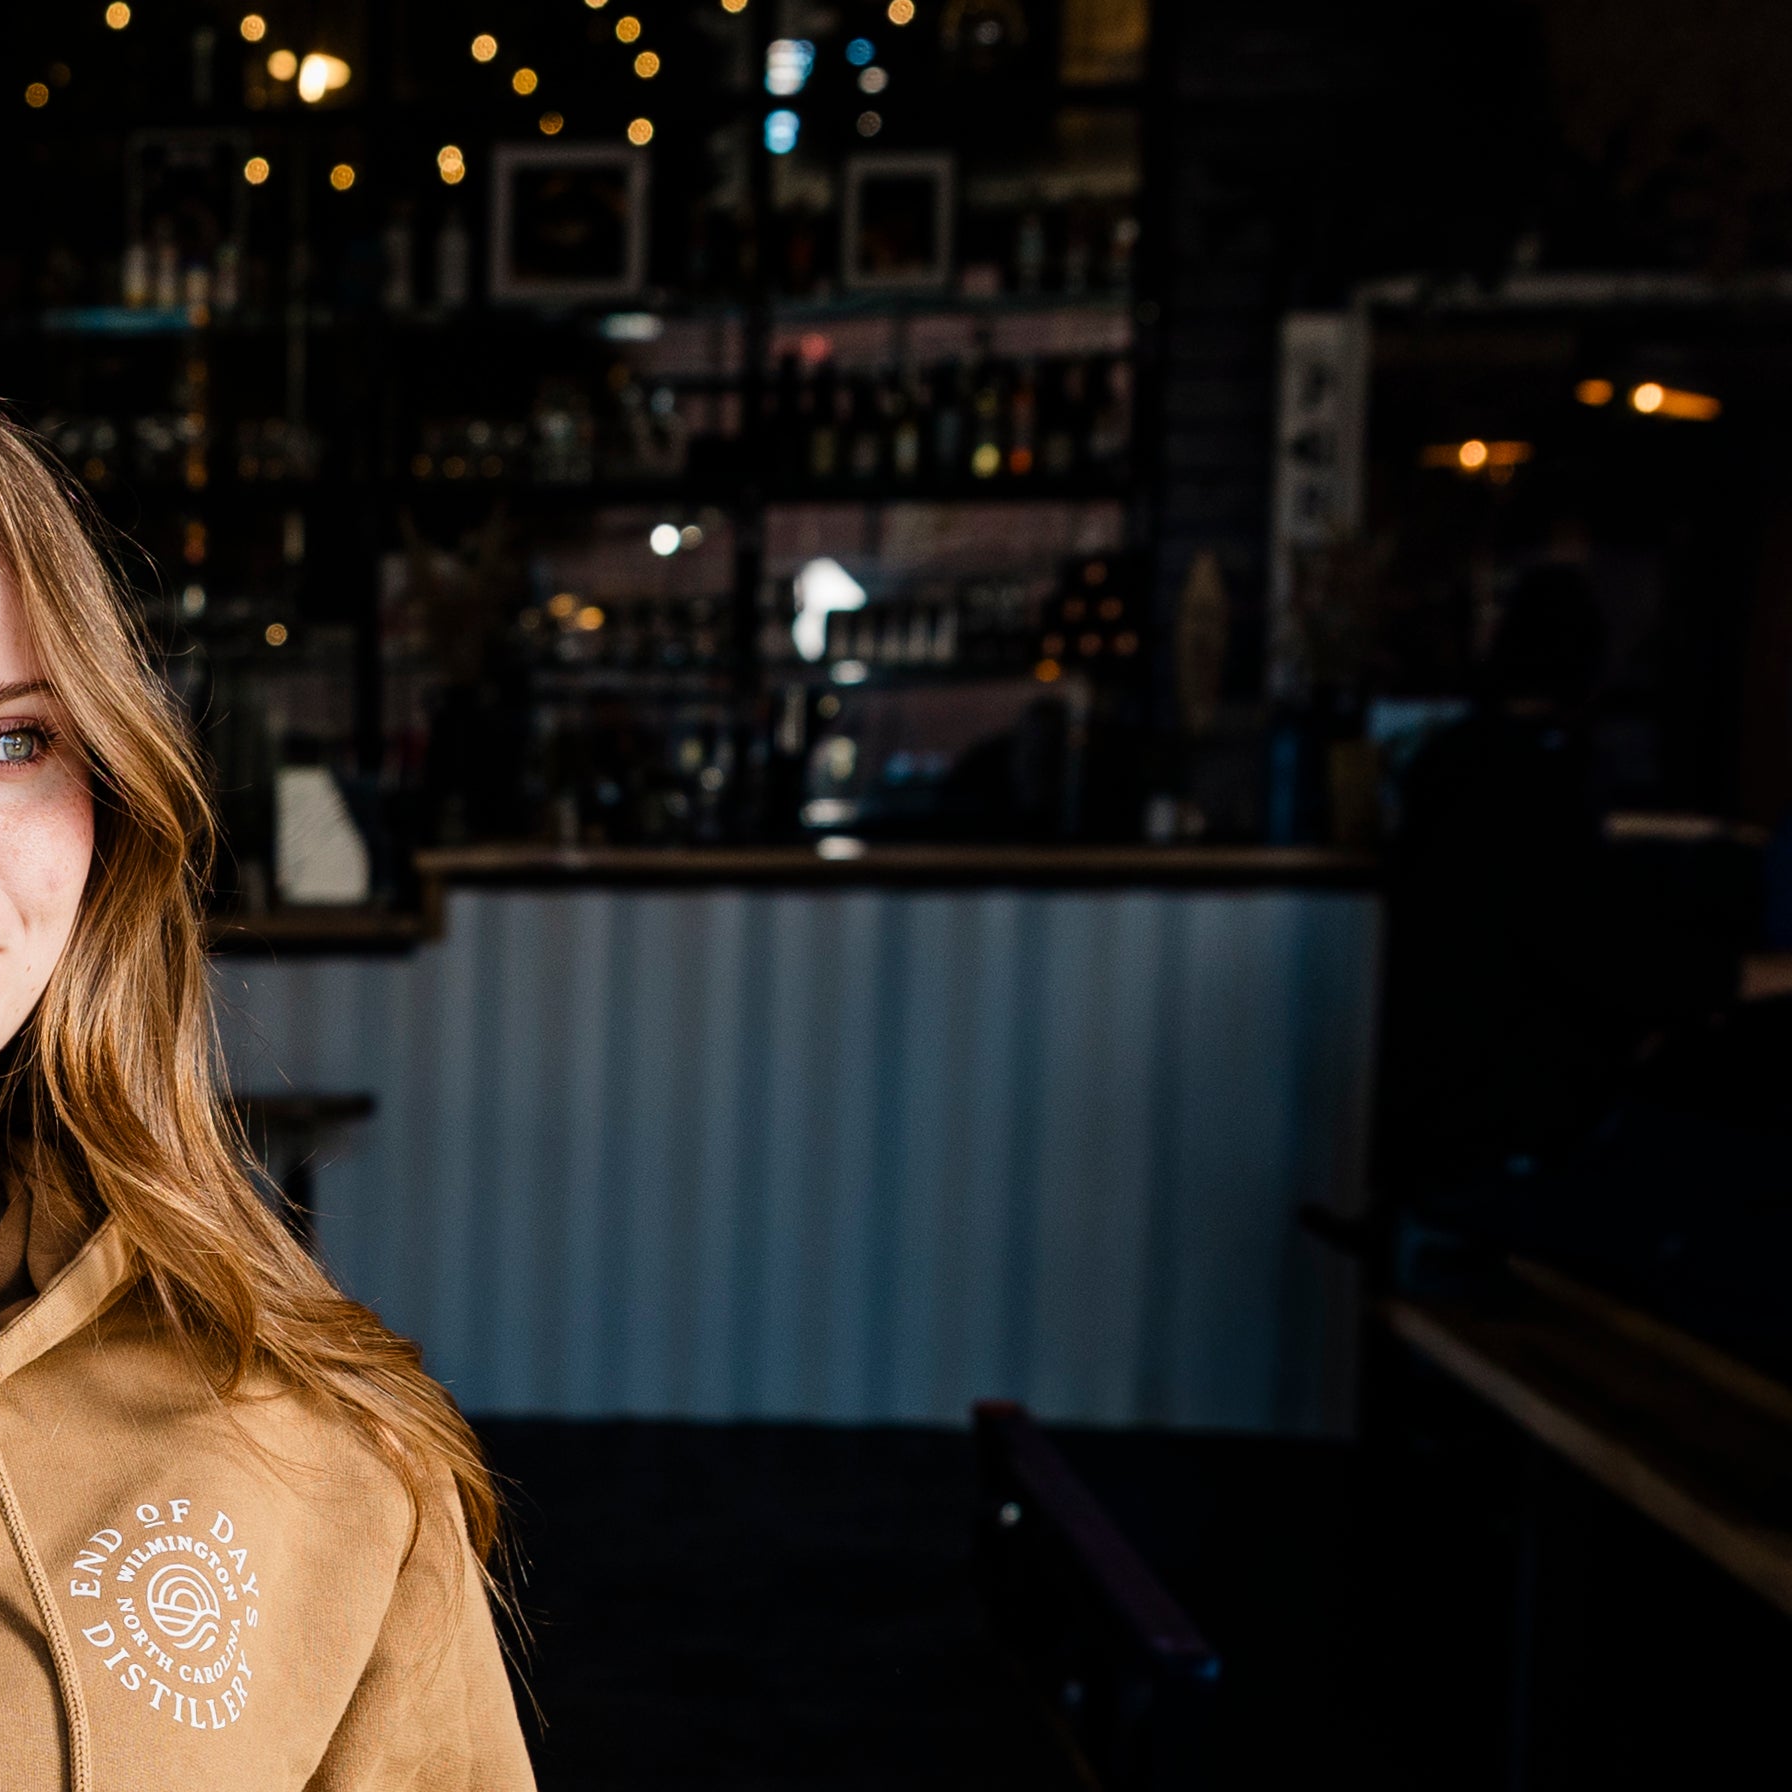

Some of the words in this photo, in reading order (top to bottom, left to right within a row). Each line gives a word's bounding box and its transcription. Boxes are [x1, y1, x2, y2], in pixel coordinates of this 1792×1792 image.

[70, 1528, 123, 1599] END
[136, 1499, 191, 1529] OF
[210, 1510, 259, 1628] DAYS
[116, 1535, 238, 1601] WILMINGTON
[81, 1620, 253, 1730] DISTILLERY
[116, 1597, 174, 1673] NORTH
[179, 1618, 241, 1684] CAROLINA
